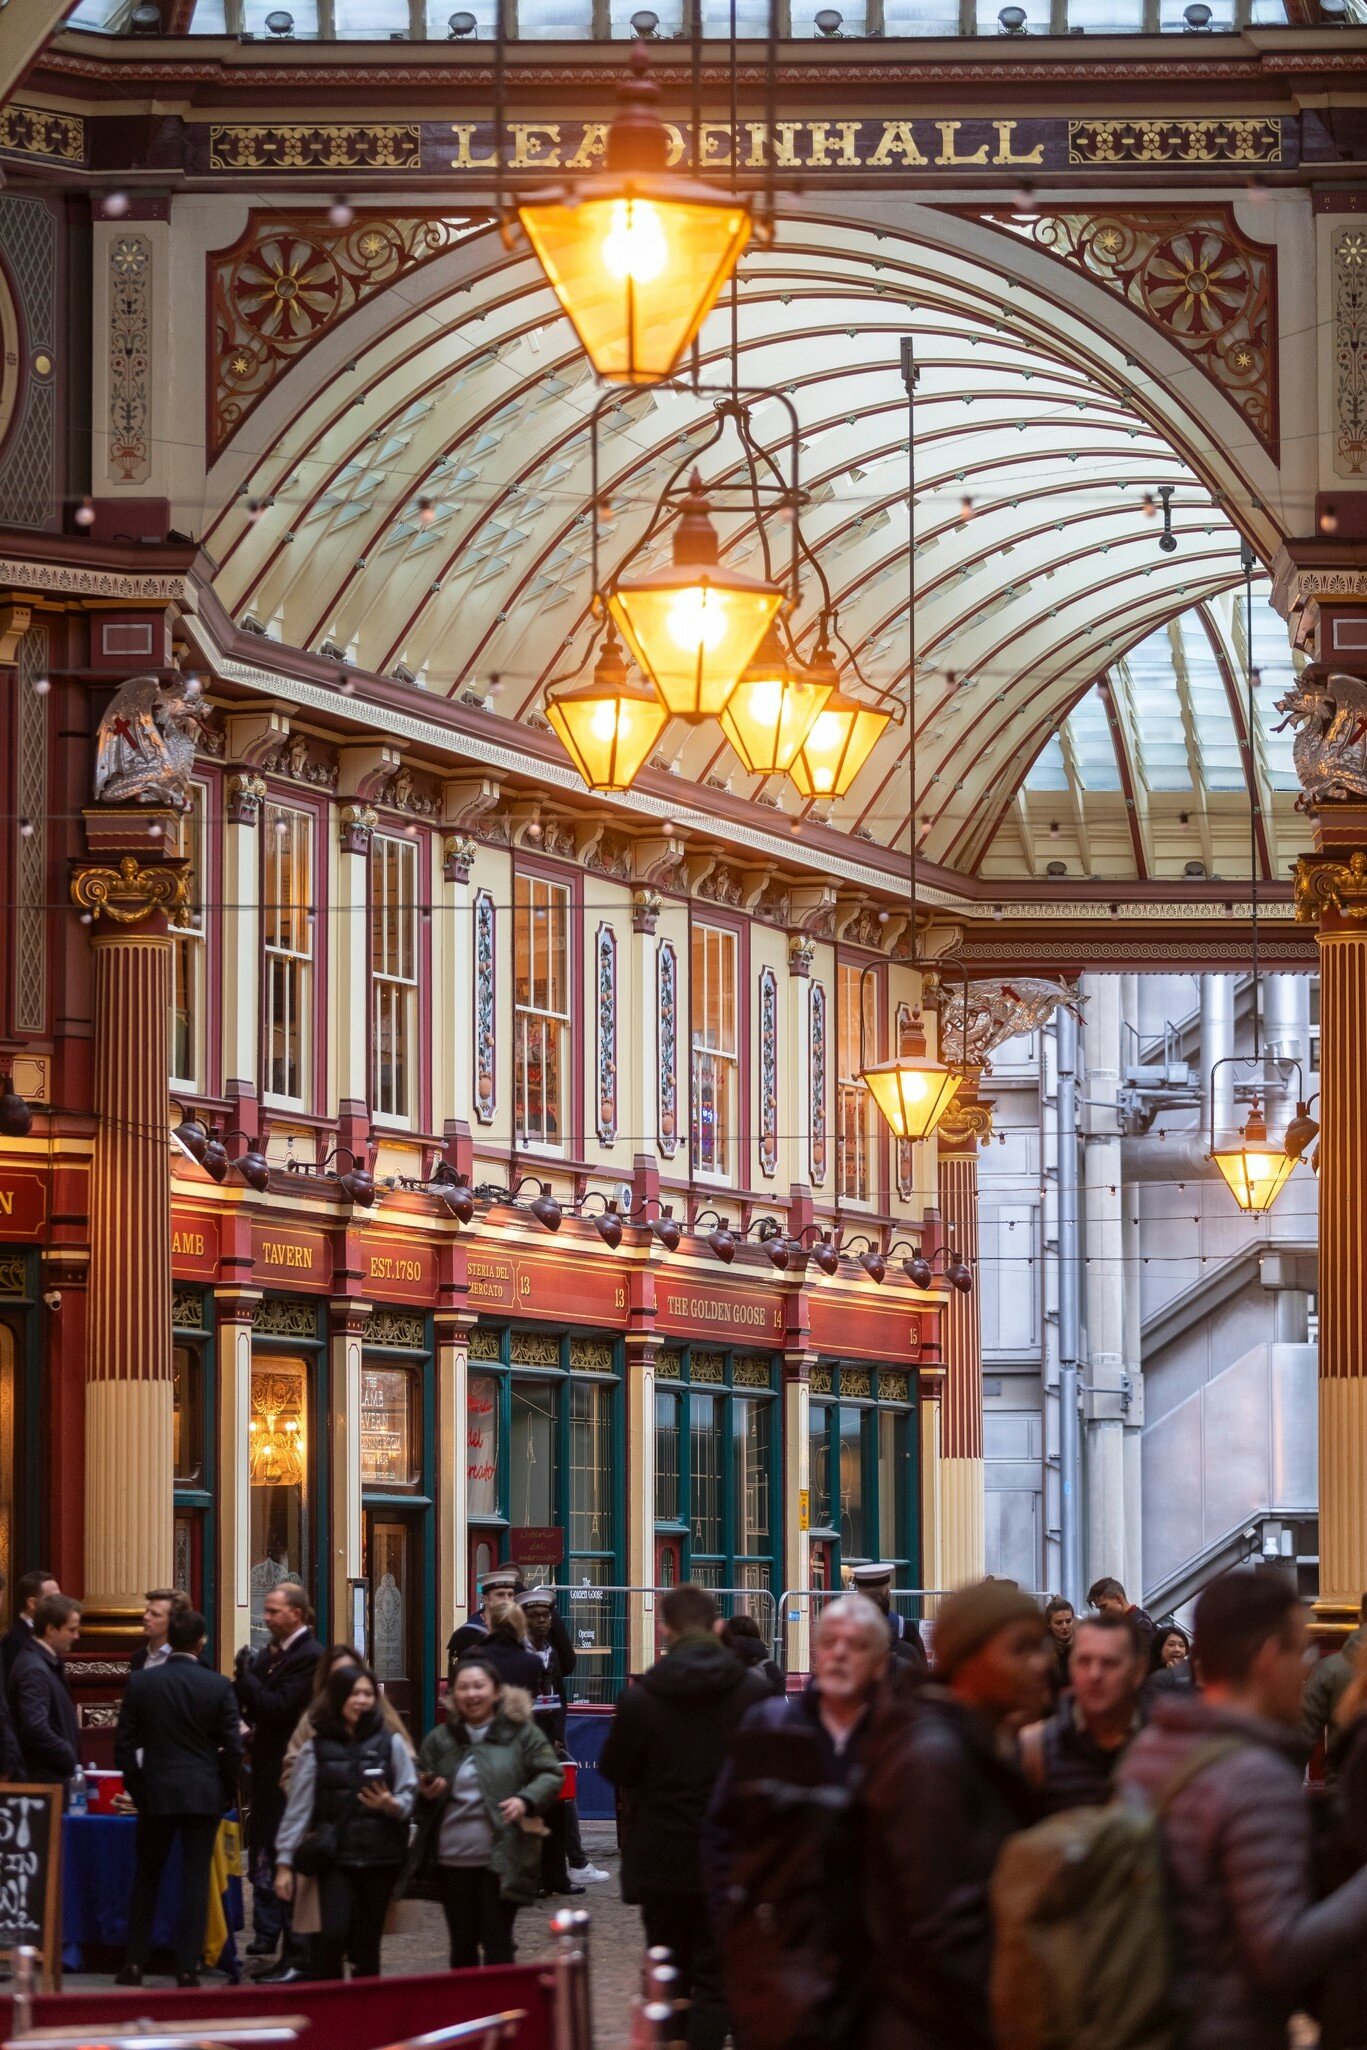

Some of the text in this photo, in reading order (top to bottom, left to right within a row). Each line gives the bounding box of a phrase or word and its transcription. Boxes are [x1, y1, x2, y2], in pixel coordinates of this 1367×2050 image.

[263, 1243, 313, 1269] TAVERN
[371, 1257, 422, 1282] EST.1780
[496, 1266, 510, 1280] DEL
[520, 1276, 531, 1295] 13
[615, 1288, 625, 1308] 13
[668, 1295, 689, 1317] THE
[690, 1299, 731, 1322] GOLDEN
[733, 1304, 766, 1326] GOOSE
[773, 1309, 782, 1328] 14
[909, 1328, 918, 1345] 15
[578, 1629, 595, 1639] Opening
